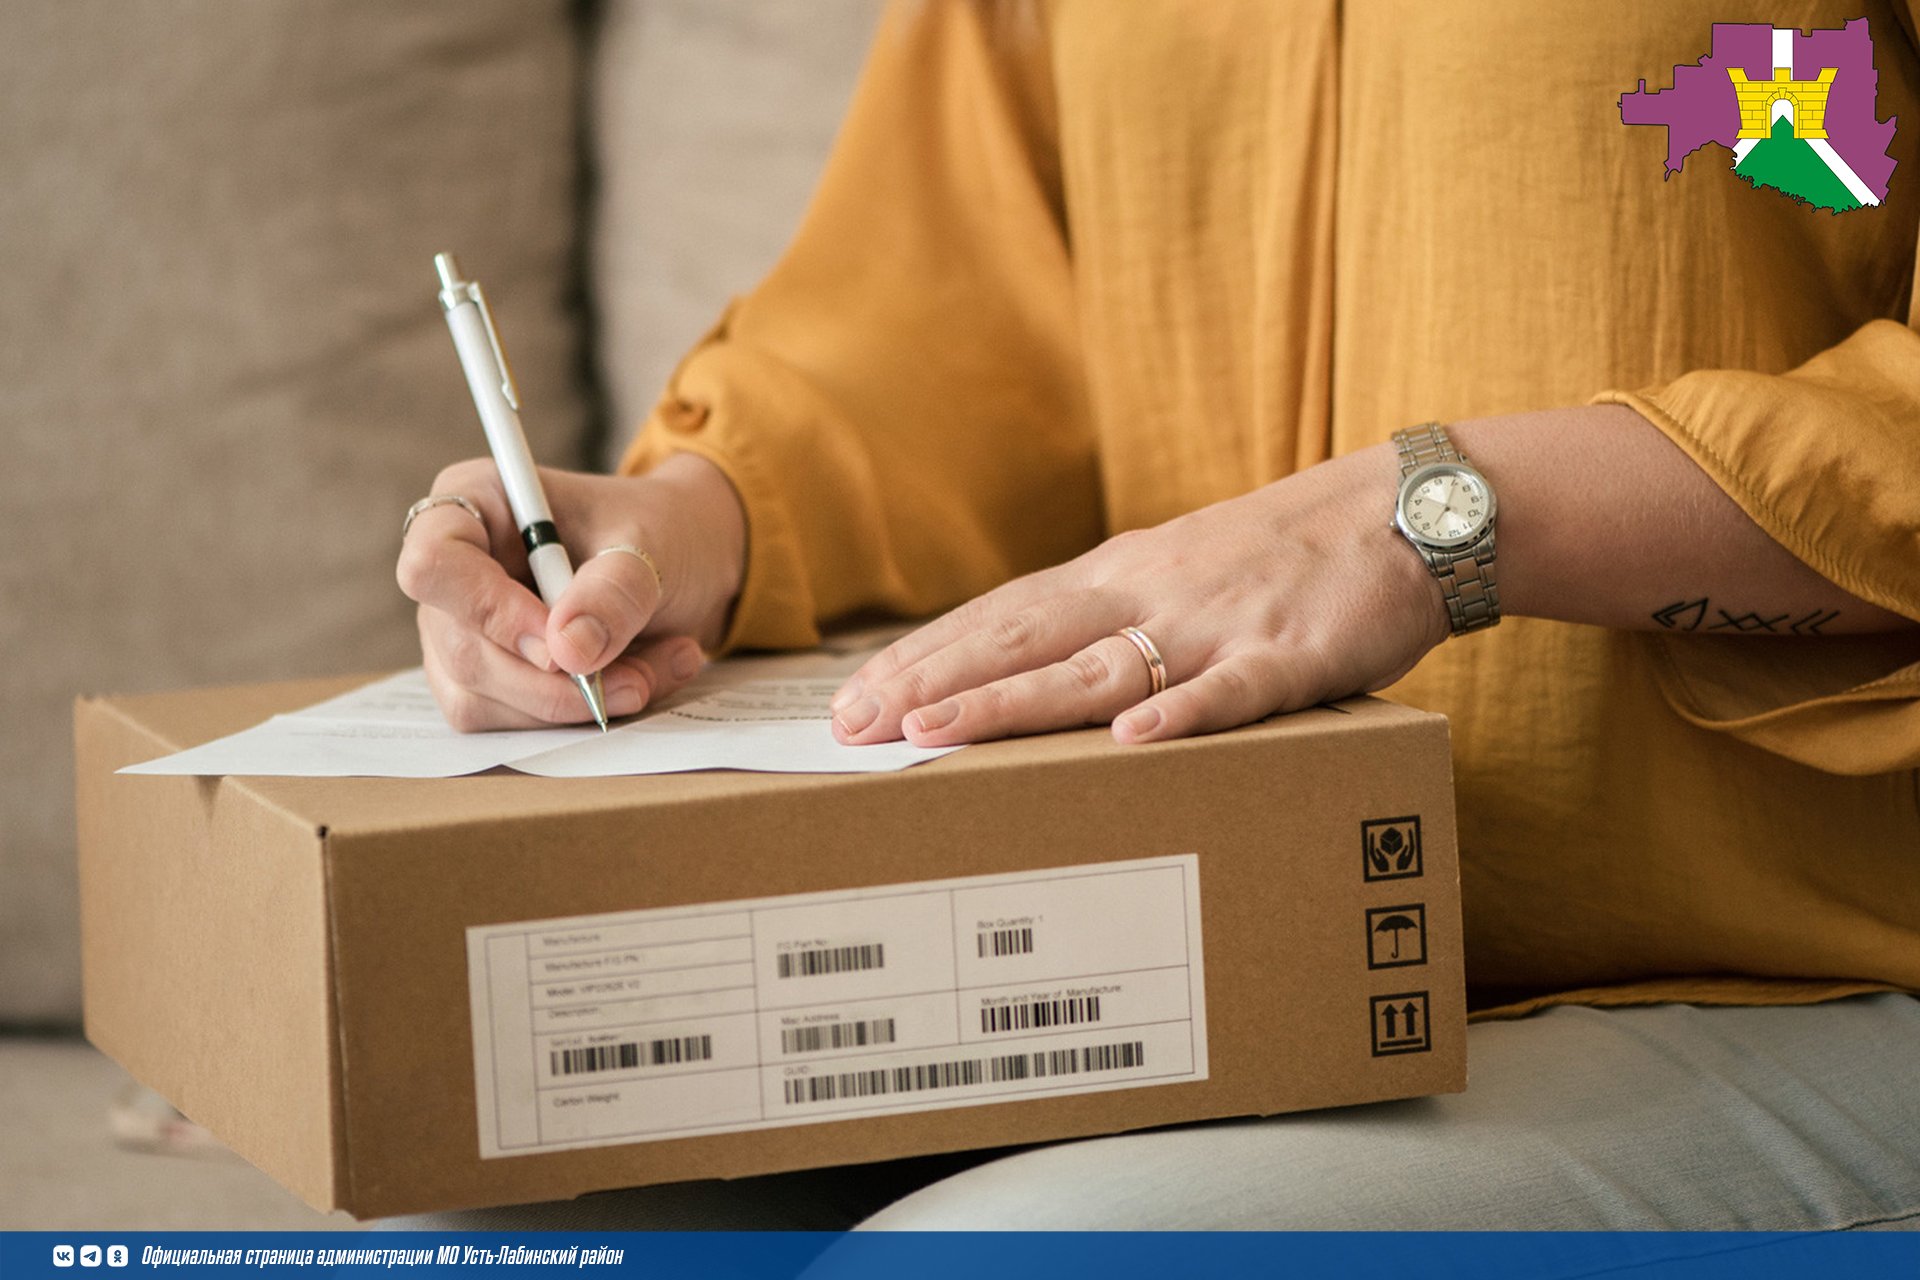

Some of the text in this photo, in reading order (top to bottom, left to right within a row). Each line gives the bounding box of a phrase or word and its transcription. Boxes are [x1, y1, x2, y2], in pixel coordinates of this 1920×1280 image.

[981, 996, 1009, 1006] Month
[1012, 994, 1028, 1003] and
[1030, 992, 1050, 1002] Year
[1052, 990, 1062, 999] of
